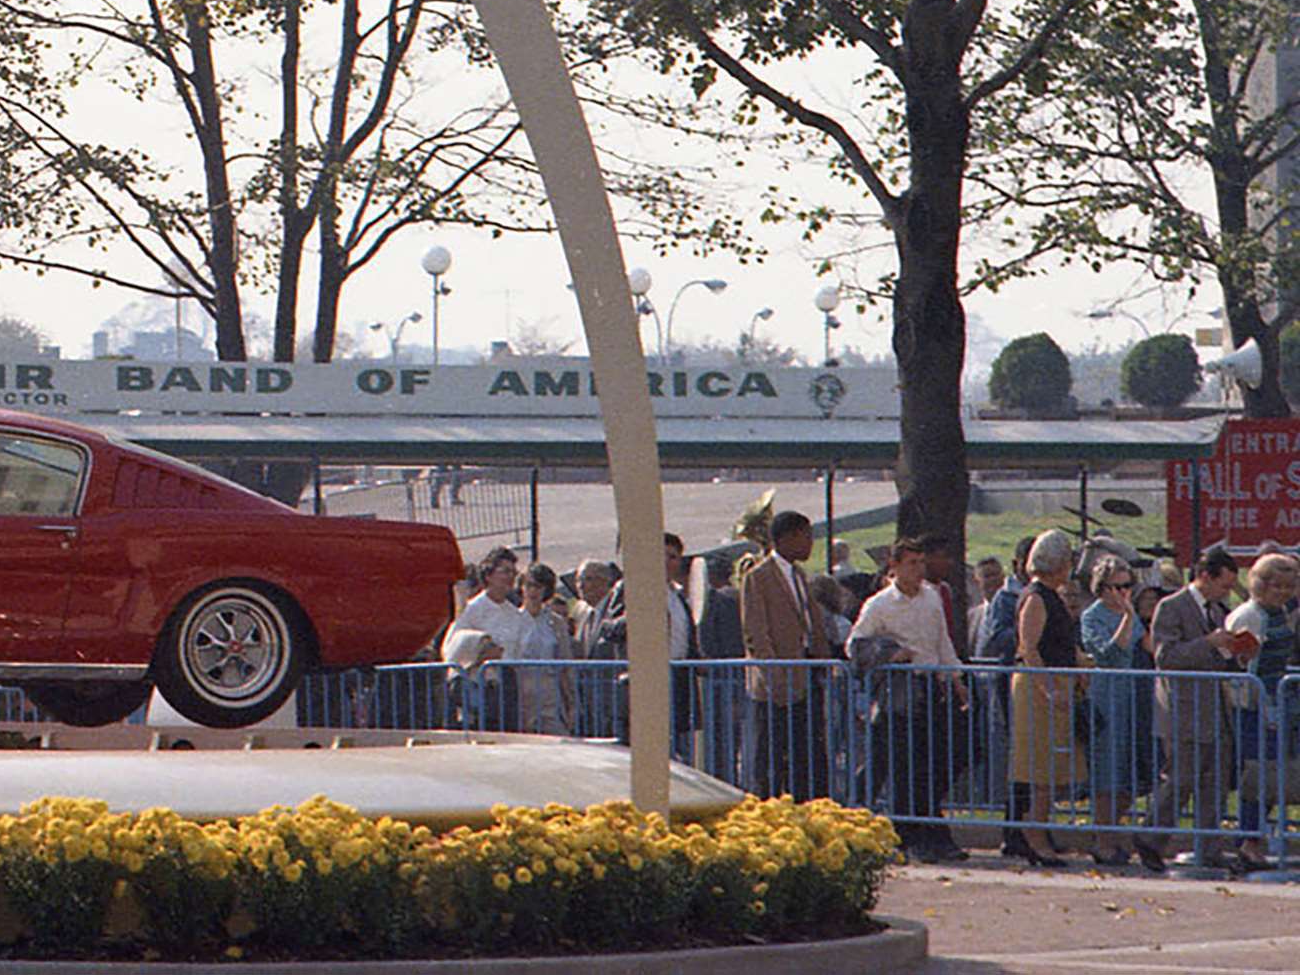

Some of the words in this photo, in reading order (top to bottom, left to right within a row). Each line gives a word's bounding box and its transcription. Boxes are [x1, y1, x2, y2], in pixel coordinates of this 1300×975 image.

[116, 366, 294, 393] BAND
[357, 369, 431, 394] OF
[488, 371, 778, 397] AMRICA
[1174, 462, 1251, 500] HALL
[1255, 473, 1283, 500] OF
[1206, 507, 1259, 528] FREE
